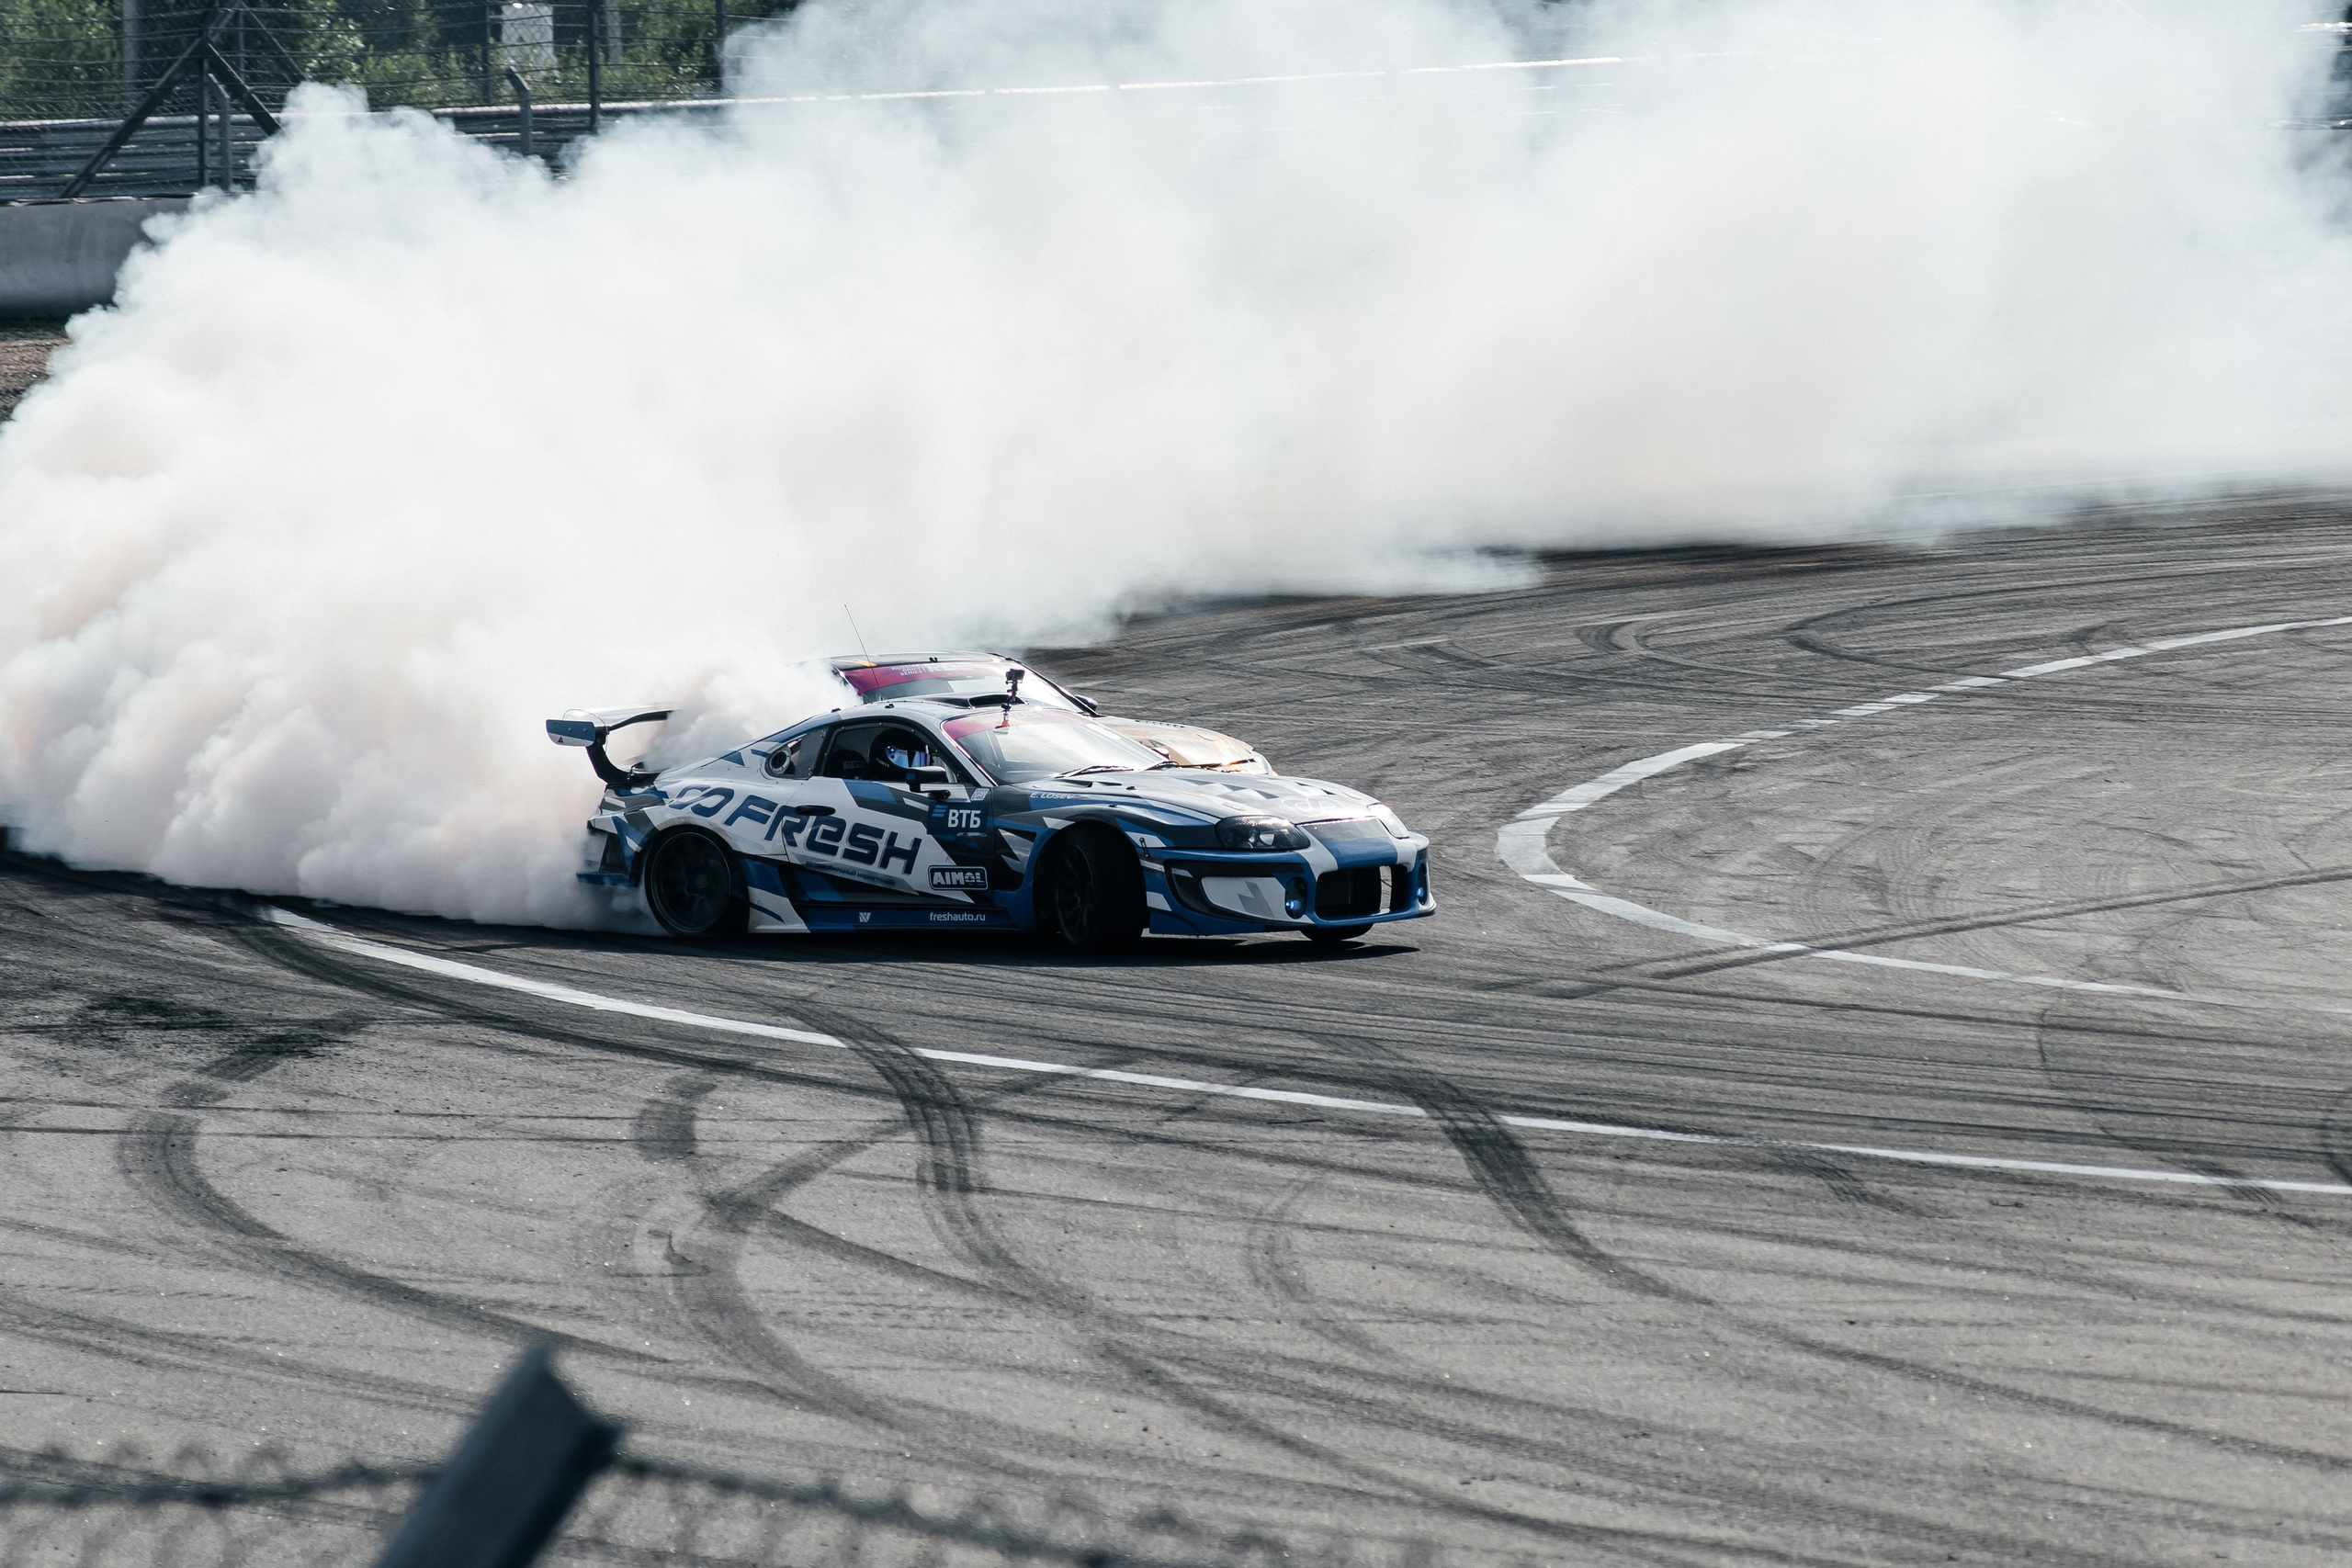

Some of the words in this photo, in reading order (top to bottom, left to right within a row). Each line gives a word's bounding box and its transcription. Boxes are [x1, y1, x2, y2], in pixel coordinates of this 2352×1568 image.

[947, 808, 981, 829] ВТБ
[933, 872, 986, 886] AIMOL
[929, 911, 986, 921] freshauto.ru
